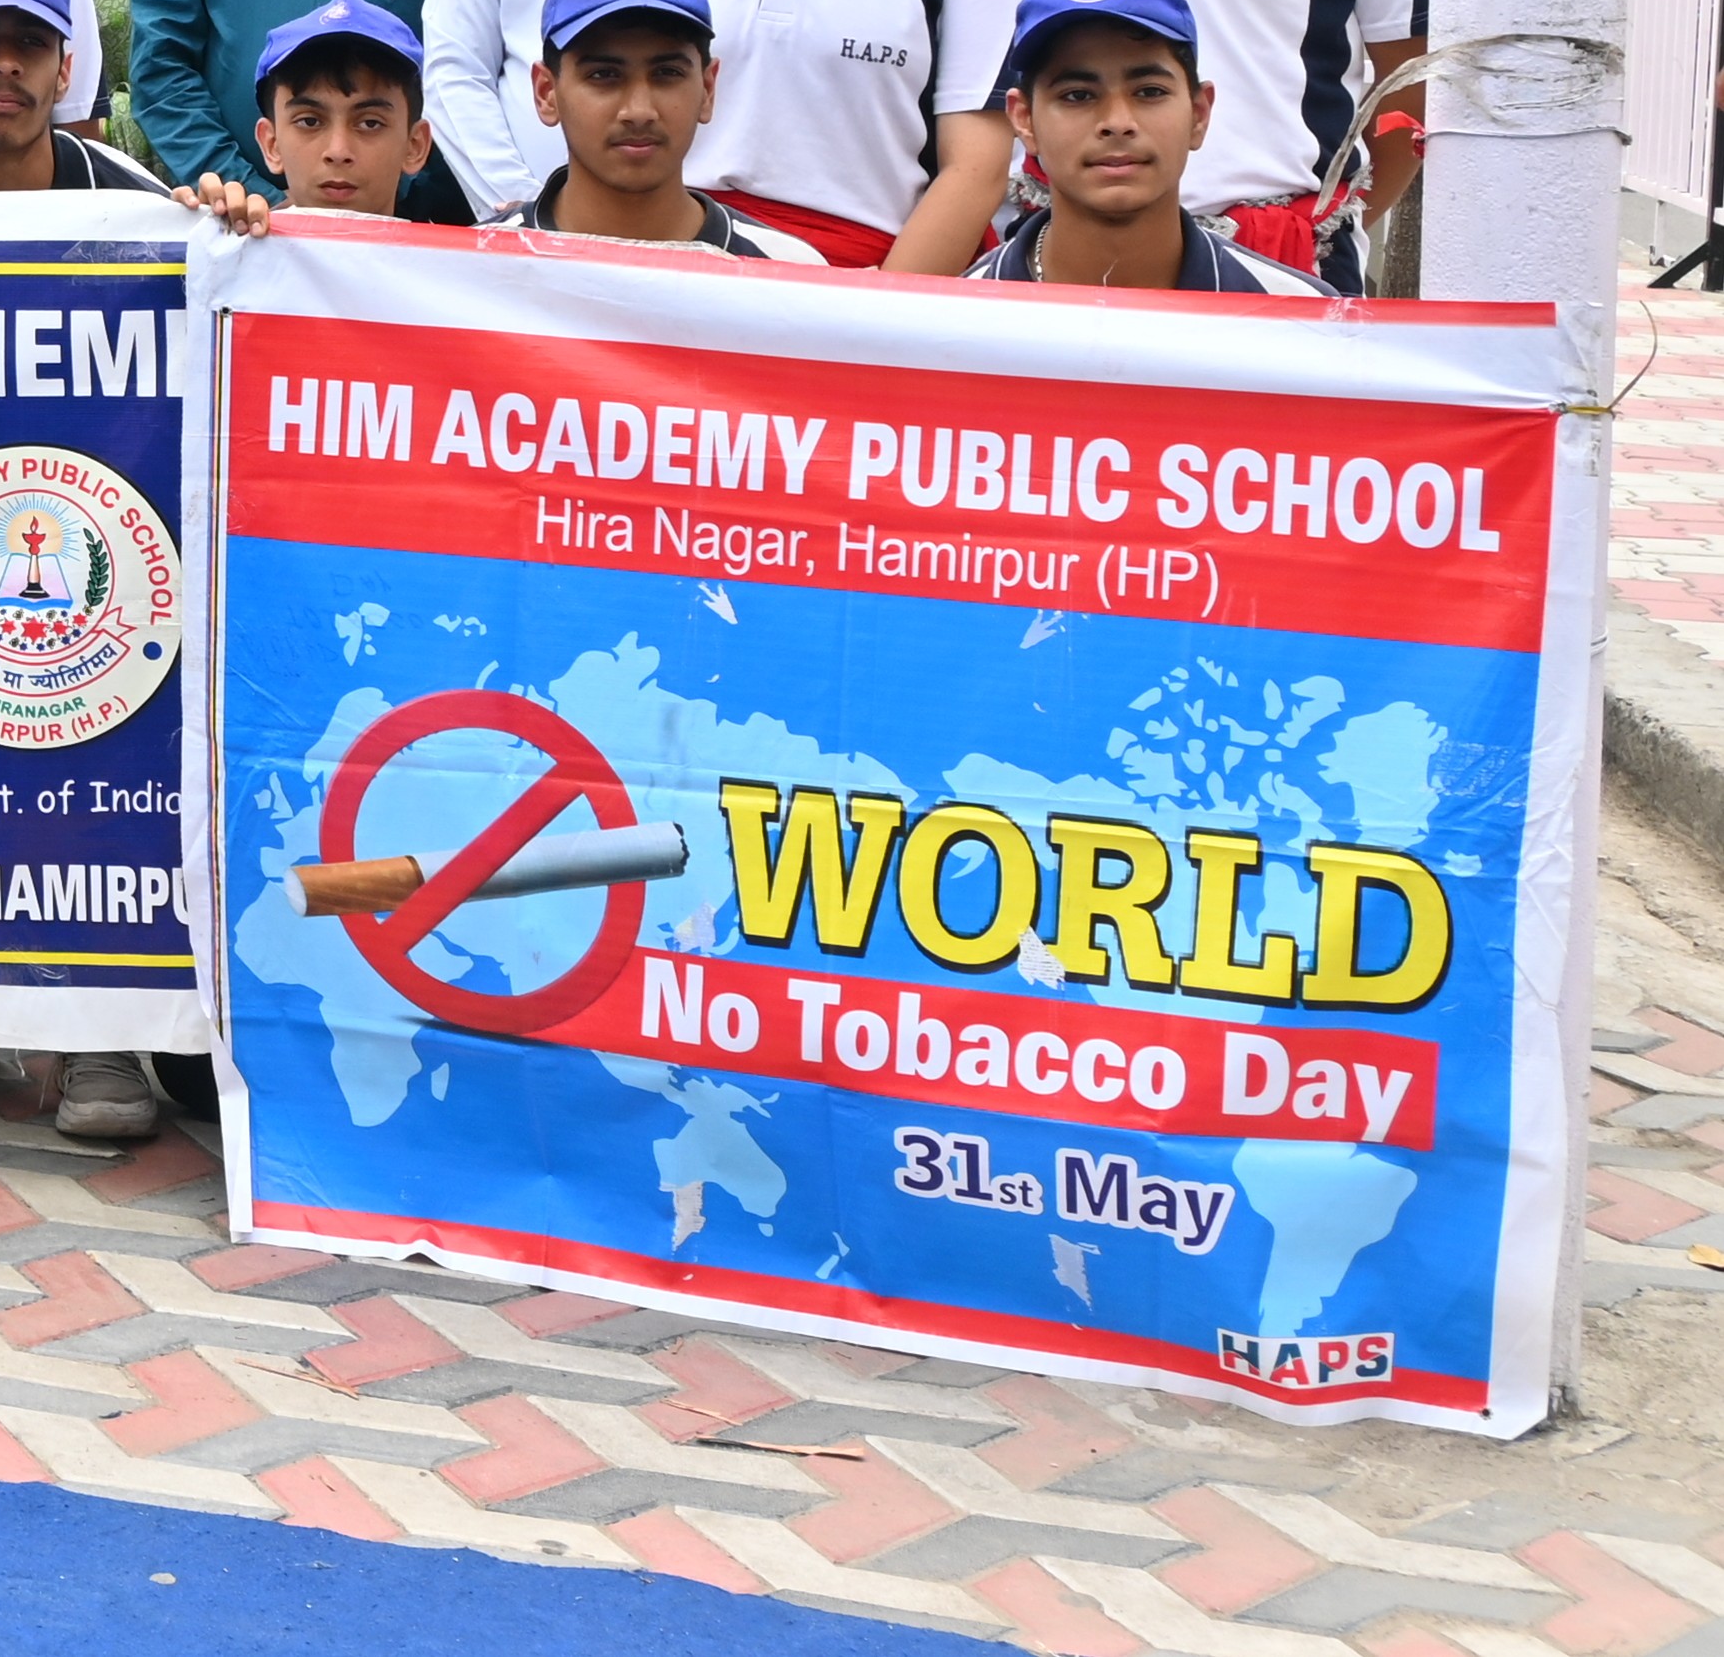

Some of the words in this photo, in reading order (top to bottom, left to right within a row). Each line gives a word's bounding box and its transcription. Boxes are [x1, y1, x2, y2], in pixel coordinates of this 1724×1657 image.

[841, 38, 909, 68] H.A.P.S
[267, 374, 414, 463] HIM
[430, 387, 828, 496] ACADEMY
[848, 420, 1131, 524] PUBLIC
[1155, 442, 1502, 554] SCHOOL
[21, 458, 121, 510] PUBLIC
[119, 507, 174, 627] SCHOOL
[535, 494, 635, 554] Hira
[652, 506, 817, 578] Nagar,
[837, 520, 1081, 600] Hamirpur
[1095, 543, 1220, 619] (HP)
[3, 669, 25, 690] मा
[71, 694, 129, 740] (H.P.)
[37, 779, 77, 815] of
[719, 776, 1454, 1015] WORLD
[641, 956, 761, 1054] No
[785, 978, 1188, 1112] Tobacco
[1221, 1030, 1415, 1144] Day
[901, 1133, 1035, 1211] 31st
[1064, 1155, 1227, 1248] May
[1221, 1331, 1390, 1387] HAPS
